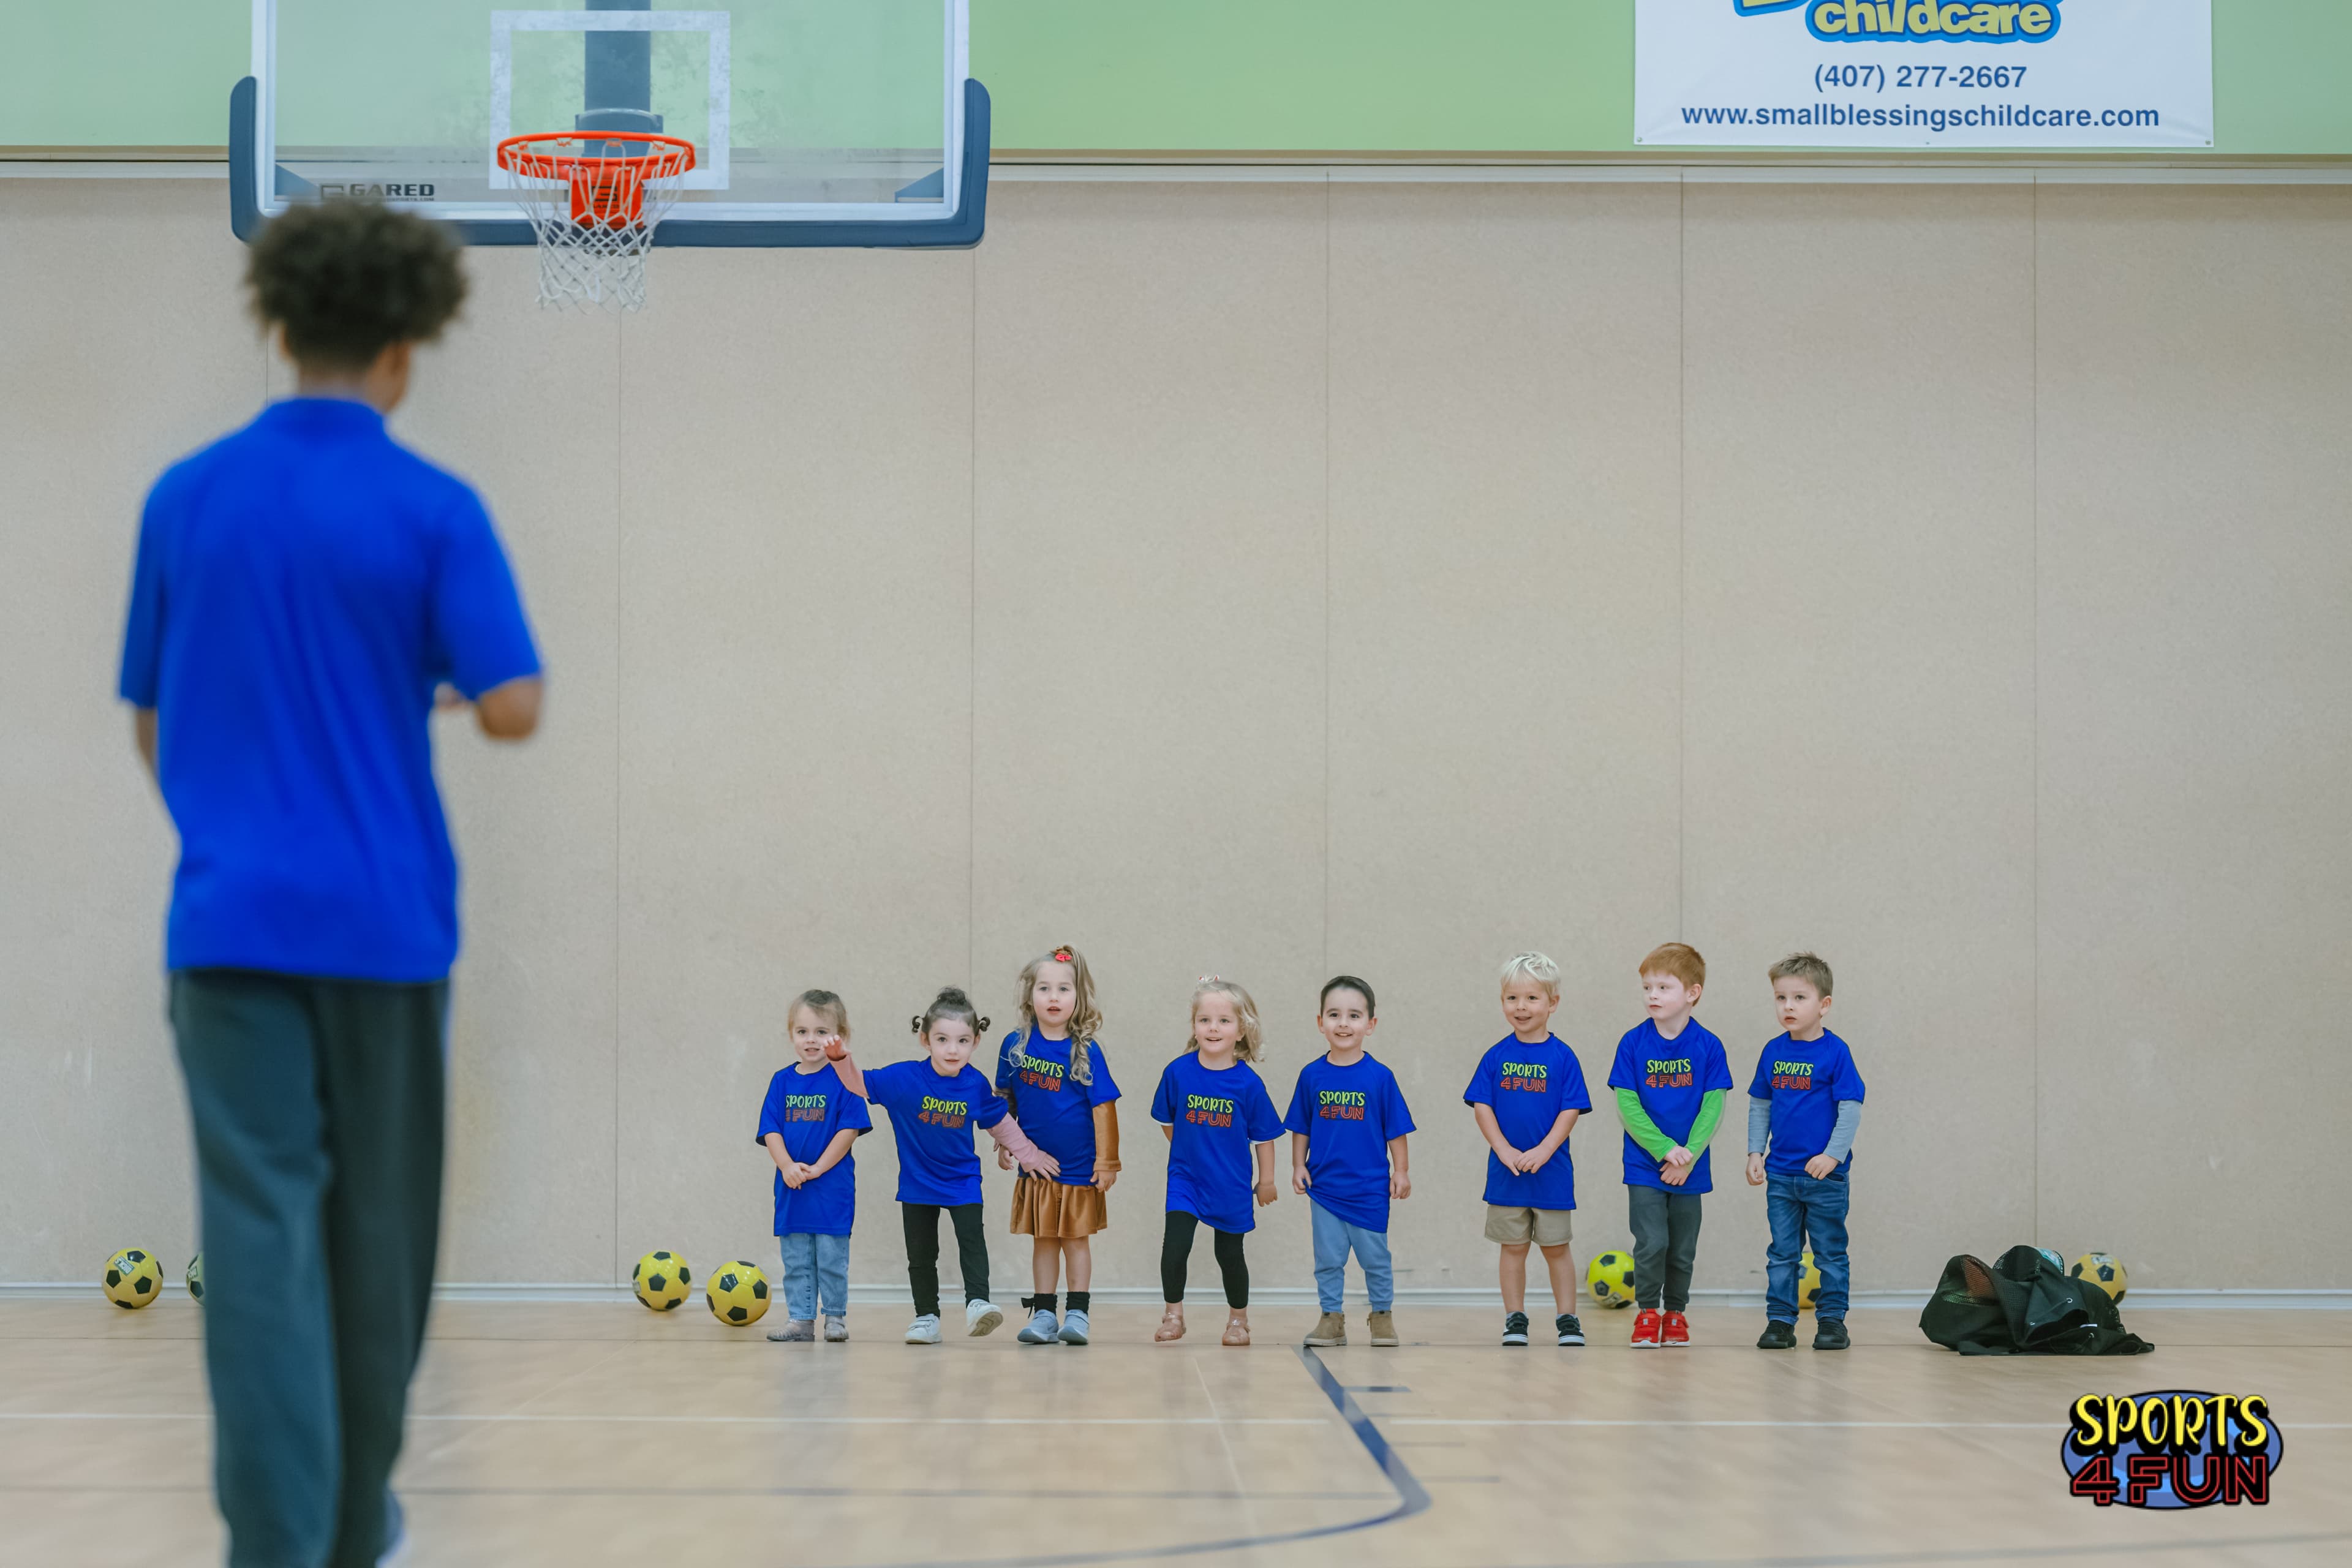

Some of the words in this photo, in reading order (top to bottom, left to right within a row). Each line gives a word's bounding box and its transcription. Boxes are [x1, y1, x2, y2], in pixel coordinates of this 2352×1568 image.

[1814, 0, 2052, 35] childcare
[1815, 64, 1885, 92] (407)
[1896, 66, 2027, 88] 277-2667
[1681, 104, 2160, 132] www.smallblessingschildcare.com
[350, 183, 435, 197] GARED
[1021, 1055, 1064, 1078] SPORTS
[1502, 1062, 1547, 1078] SPORTS
[1646, 1058, 1691, 1074] SPORTS
[1773, 1061, 1814, 1076] SPORTS
[922, 1095, 967, 1115] SPORTS
[1187, 1094, 1234, 1114] SPORTS
[1319, 1091, 1365, 1106] SPORTS
